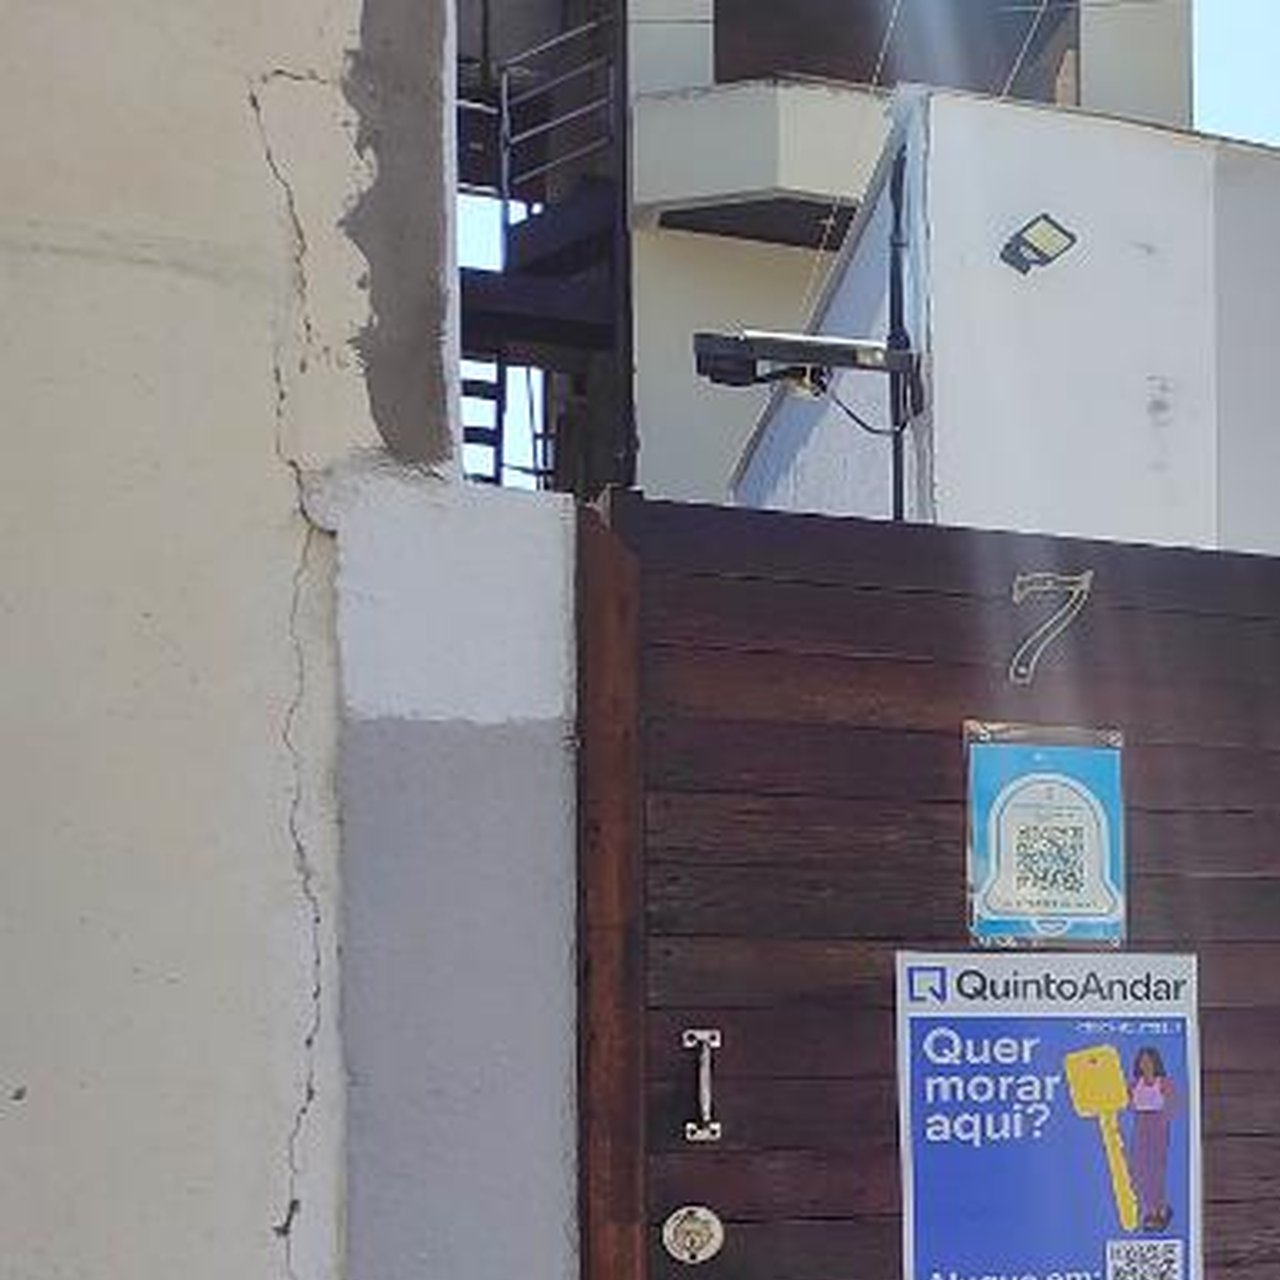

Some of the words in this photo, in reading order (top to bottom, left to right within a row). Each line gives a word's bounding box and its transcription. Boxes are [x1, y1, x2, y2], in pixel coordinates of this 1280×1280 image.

[1010, 570, 1094, 684] 7
[956, 969, 1188, 1002] QuintoAndar
[923, 1027, 1040, 1066] Quer
[926, 1074, 1061, 1104] morar
[926, 1103, 1050, 1147] aqui?
